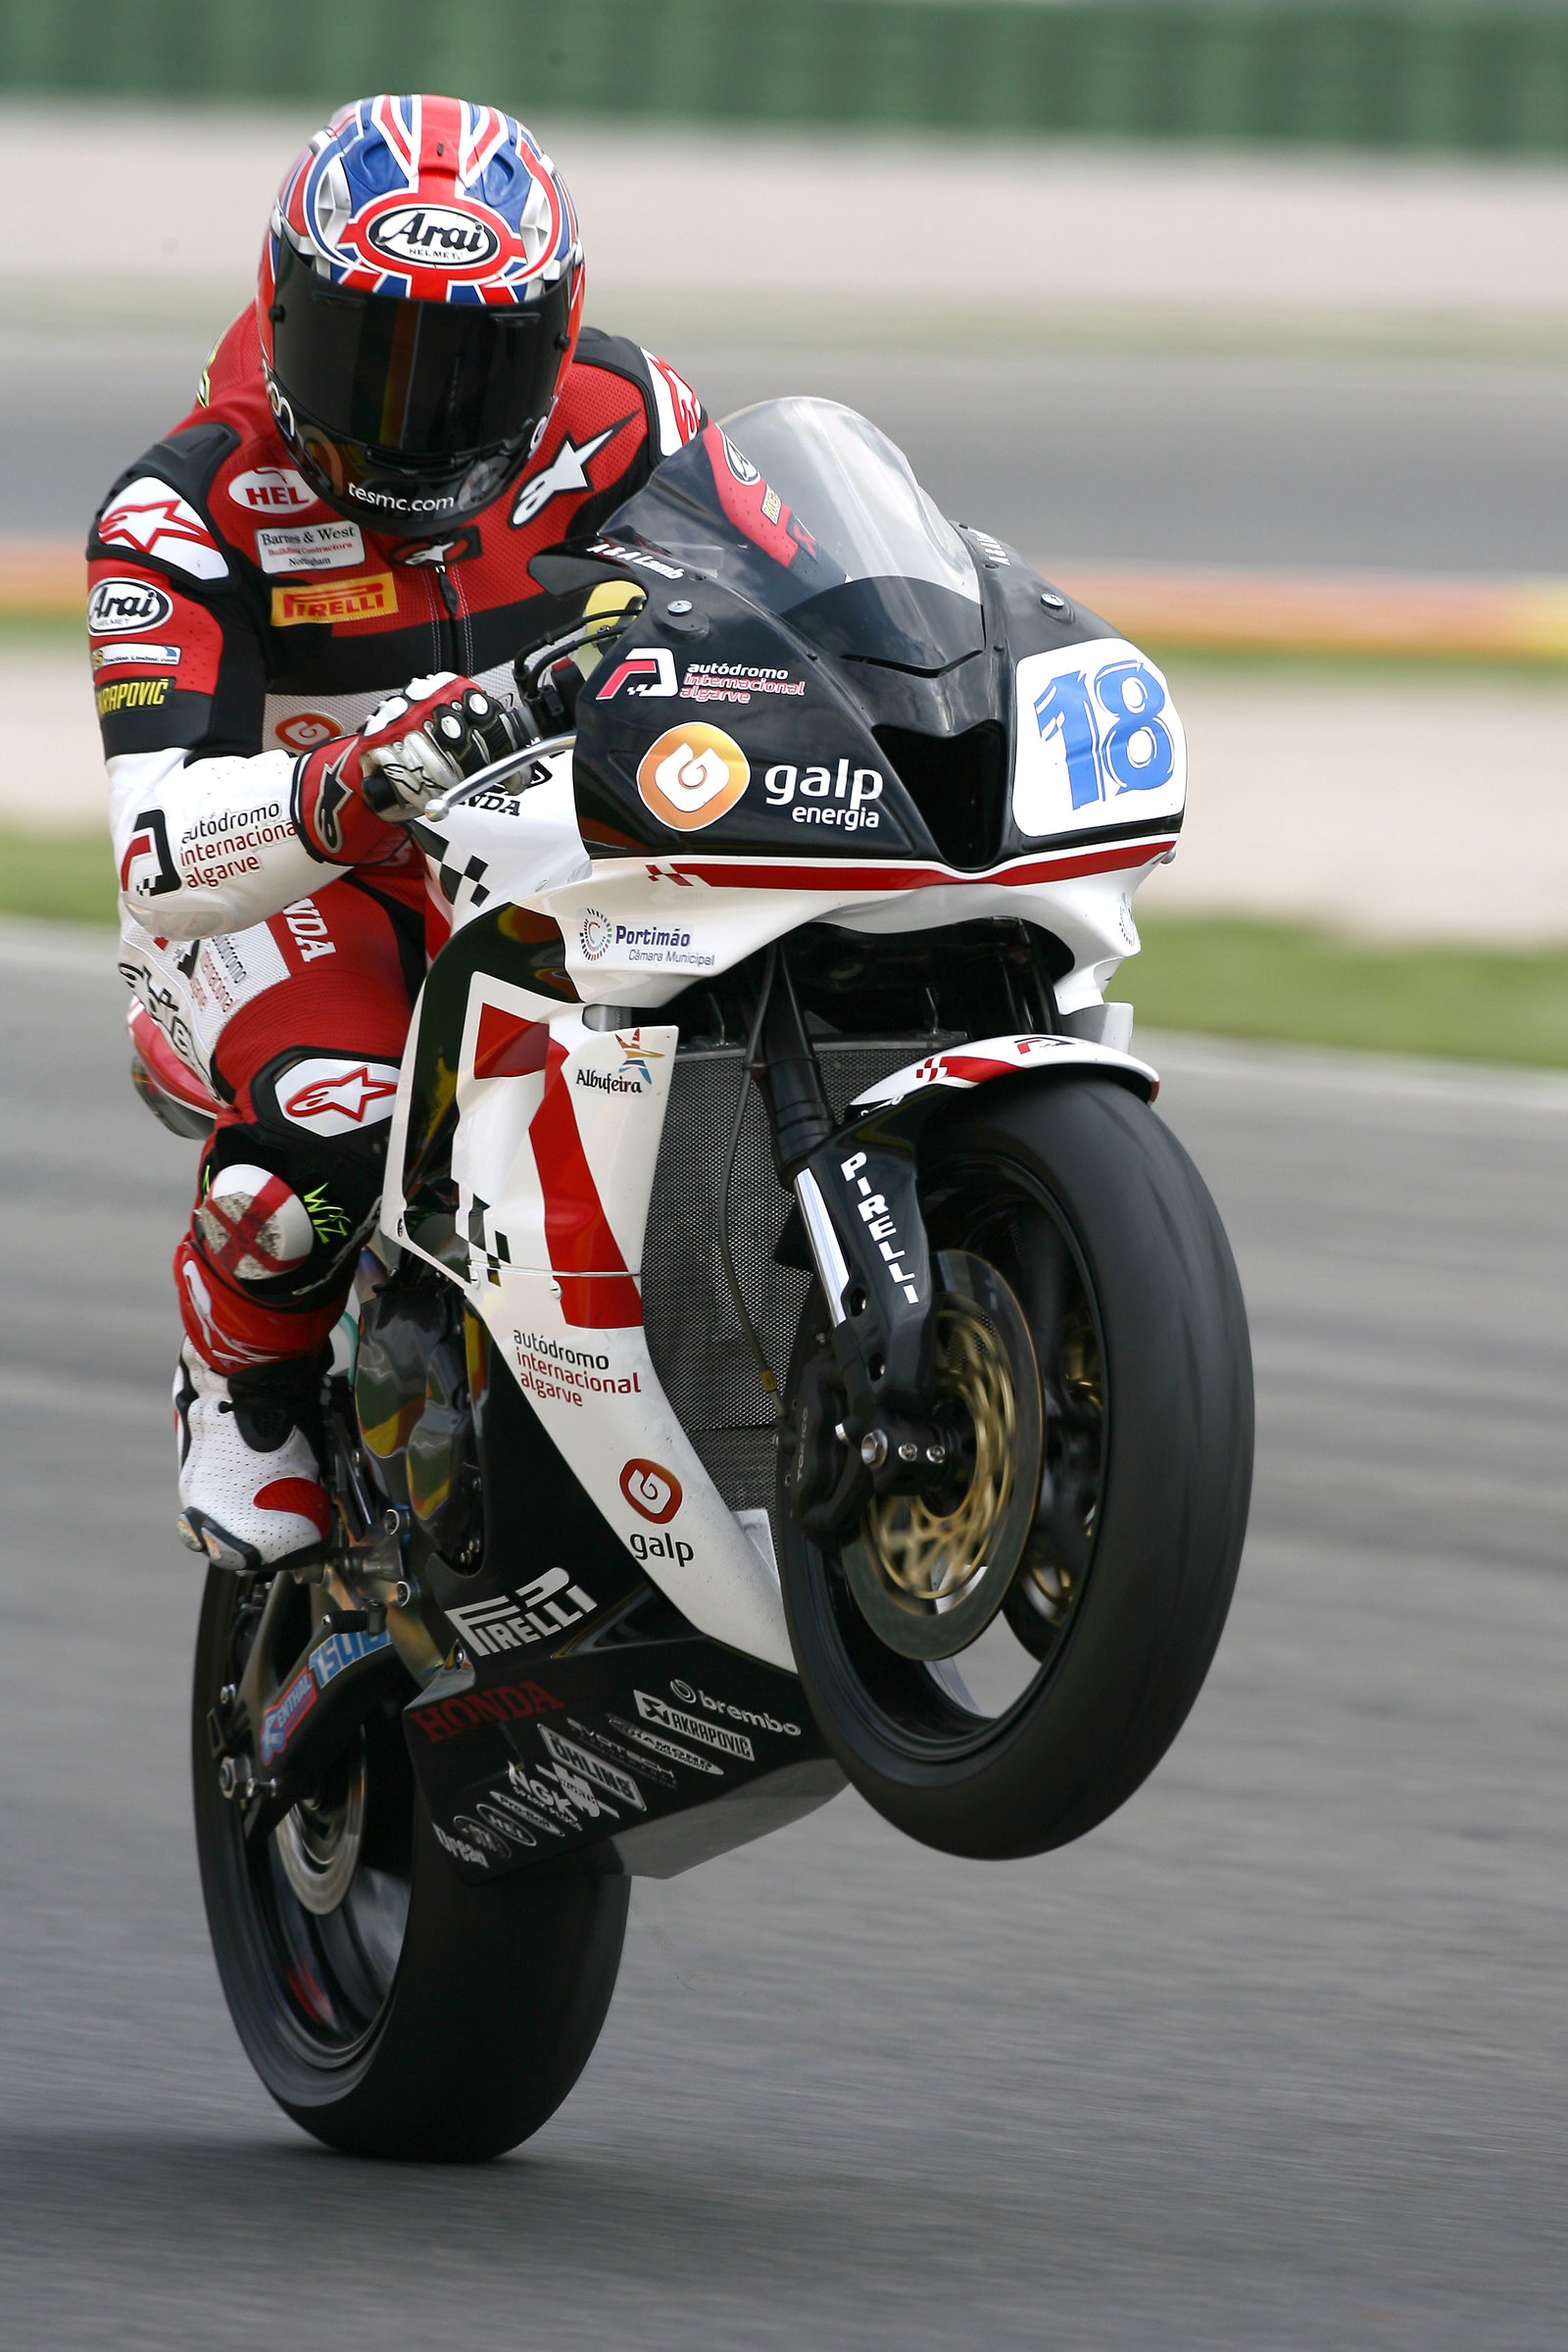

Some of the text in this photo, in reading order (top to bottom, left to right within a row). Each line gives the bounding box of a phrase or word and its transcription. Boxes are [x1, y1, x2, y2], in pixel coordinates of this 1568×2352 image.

[376, 212, 483, 252] Arai
[246, 486, 310, 506] HEL
[348, 482, 455, 512] tesmc.com
[261, 525, 356, 546] Barnes & West
[94, 587, 155, 617] Arai
[283, 582, 385, 618] PIRELLI
[683, 672, 807, 697] internacional
[687, 662, 789, 680] autódromo
[679, 685, 752, 705] algarve
[1034, 660, 1175, 810] 18
[764, 758, 884, 810] galp
[181, 803, 279, 844] autódromo
[792, 805, 880, 831] energia
[180, 821, 297, 866] internaciona
[185, 856, 261, 888] algarve
[615, 924, 691, 948] Portimão
[628, 949, 715, 966] Câmara Municipal
[575, 1069, 643, 1095] Albufeira
[840, 1152, 919, 1304] PIRELLI
[514, 1329, 610, 1370] autódromo
[515, 1347, 642, 1394] internacional
[520, 1372, 583, 1406] algarve
[629, 1533, 694, 1567] galp
[444, 1567, 598, 1656] PIRELLI
[409, 1680, 565, 1741] HONDA
[699, 1690, 802, 1737] brembo
[508, 1760, 578, 1821] NGK
